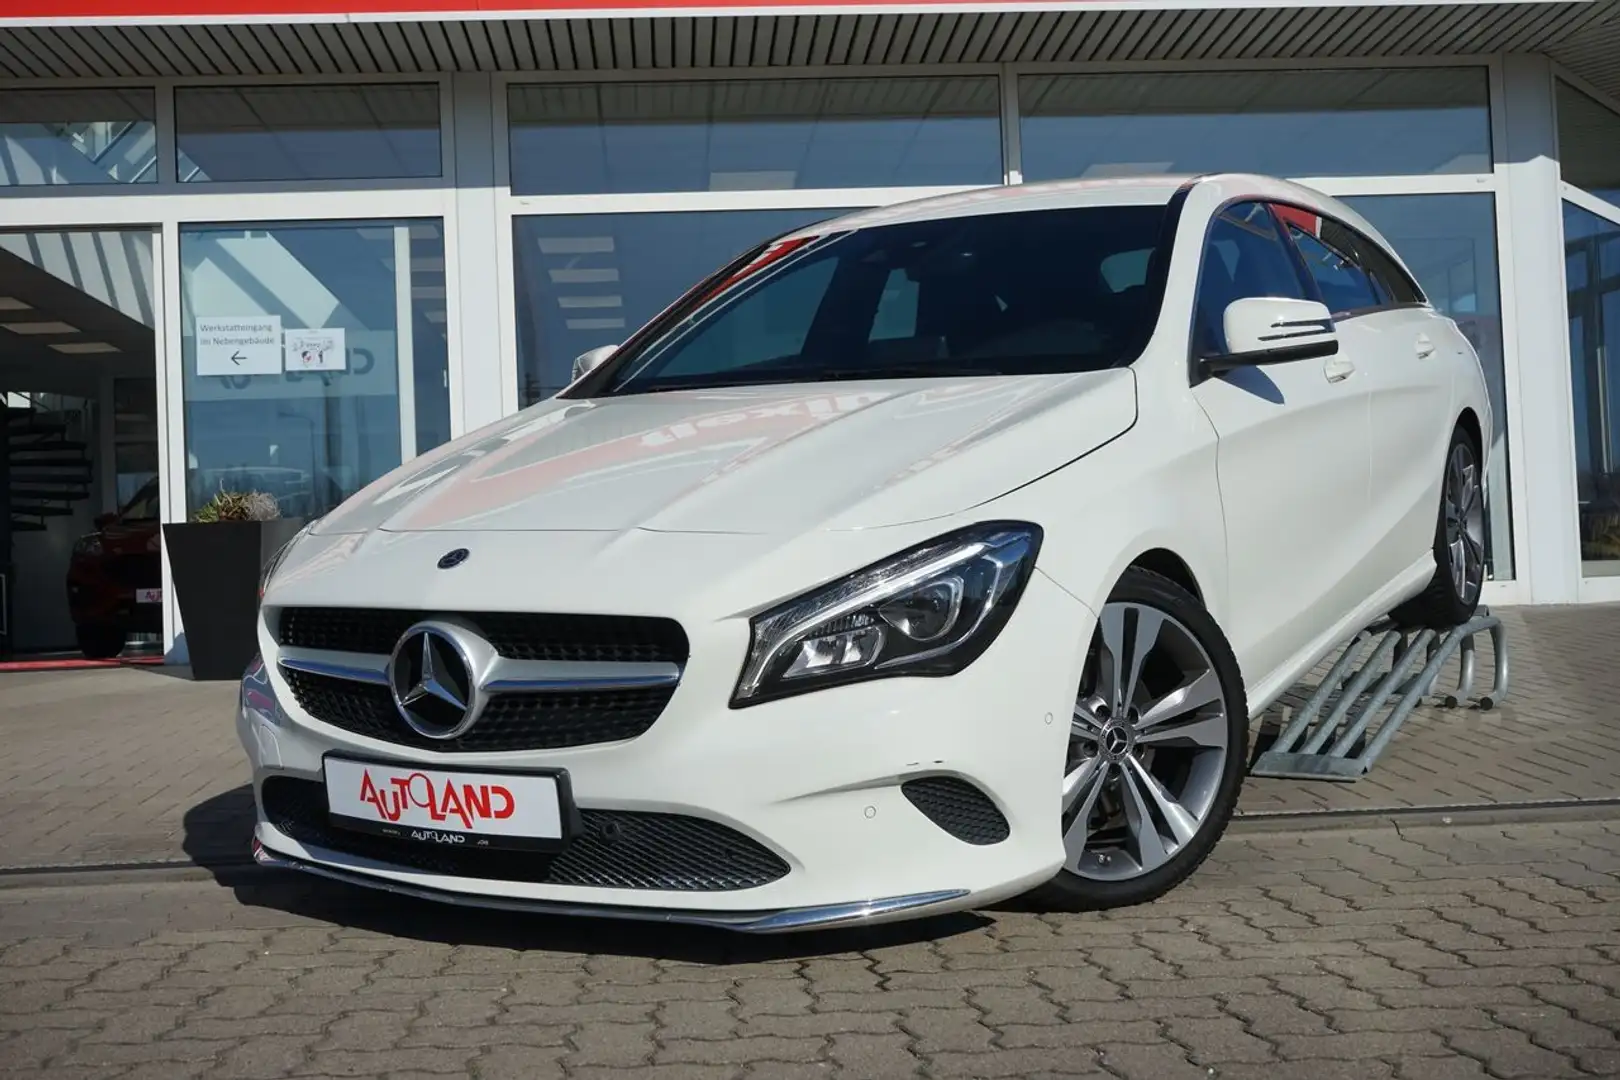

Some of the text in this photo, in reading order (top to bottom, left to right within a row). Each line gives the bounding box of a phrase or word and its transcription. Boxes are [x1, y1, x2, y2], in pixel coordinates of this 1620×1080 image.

[200, 323, 273, 333] Werkstatteingang
[213, 336, 275, 346] Nebengebäude
[360, 768, 516, 829] AUTOLAND
[411, 830, 465, 844] AUTOLAND
